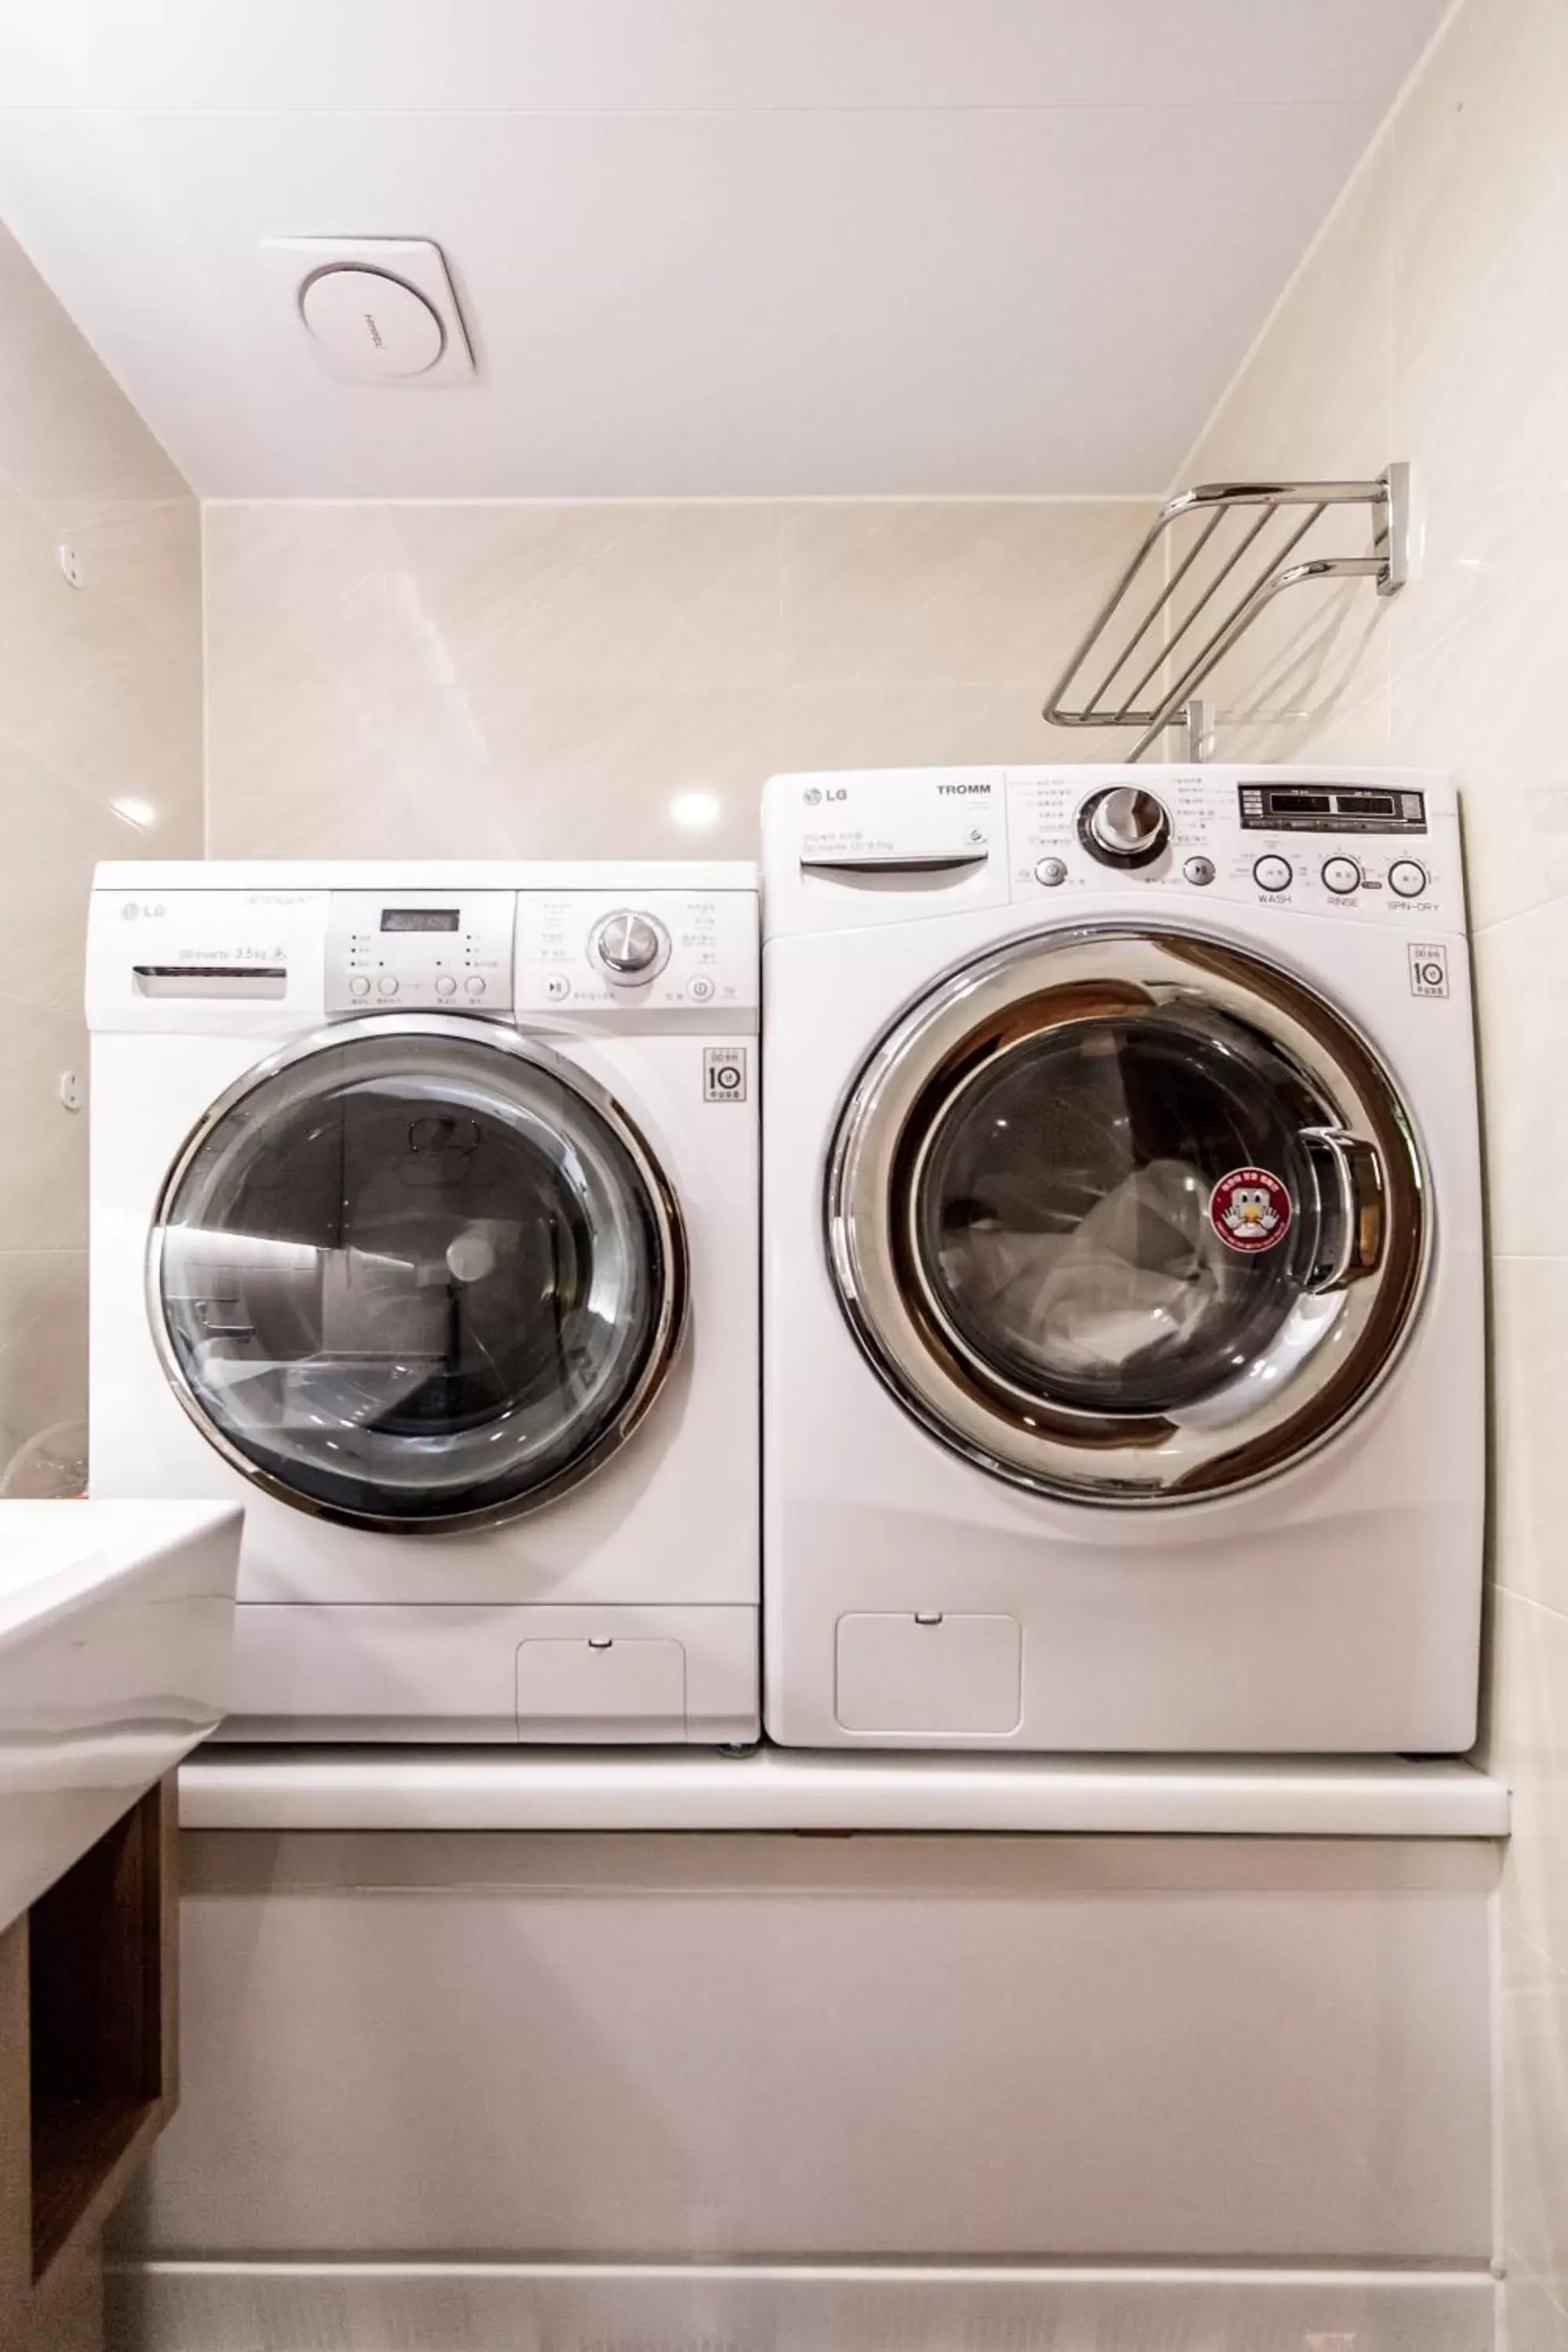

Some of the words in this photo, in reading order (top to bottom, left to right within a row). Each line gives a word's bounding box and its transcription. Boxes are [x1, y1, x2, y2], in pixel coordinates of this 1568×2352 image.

[826, 789, 848, 801] LG
[936, 784, 991, 795] TROMM
[1258, 895, 1292, 904] WASH
[1327, 896, 1359, 907] RINSE
